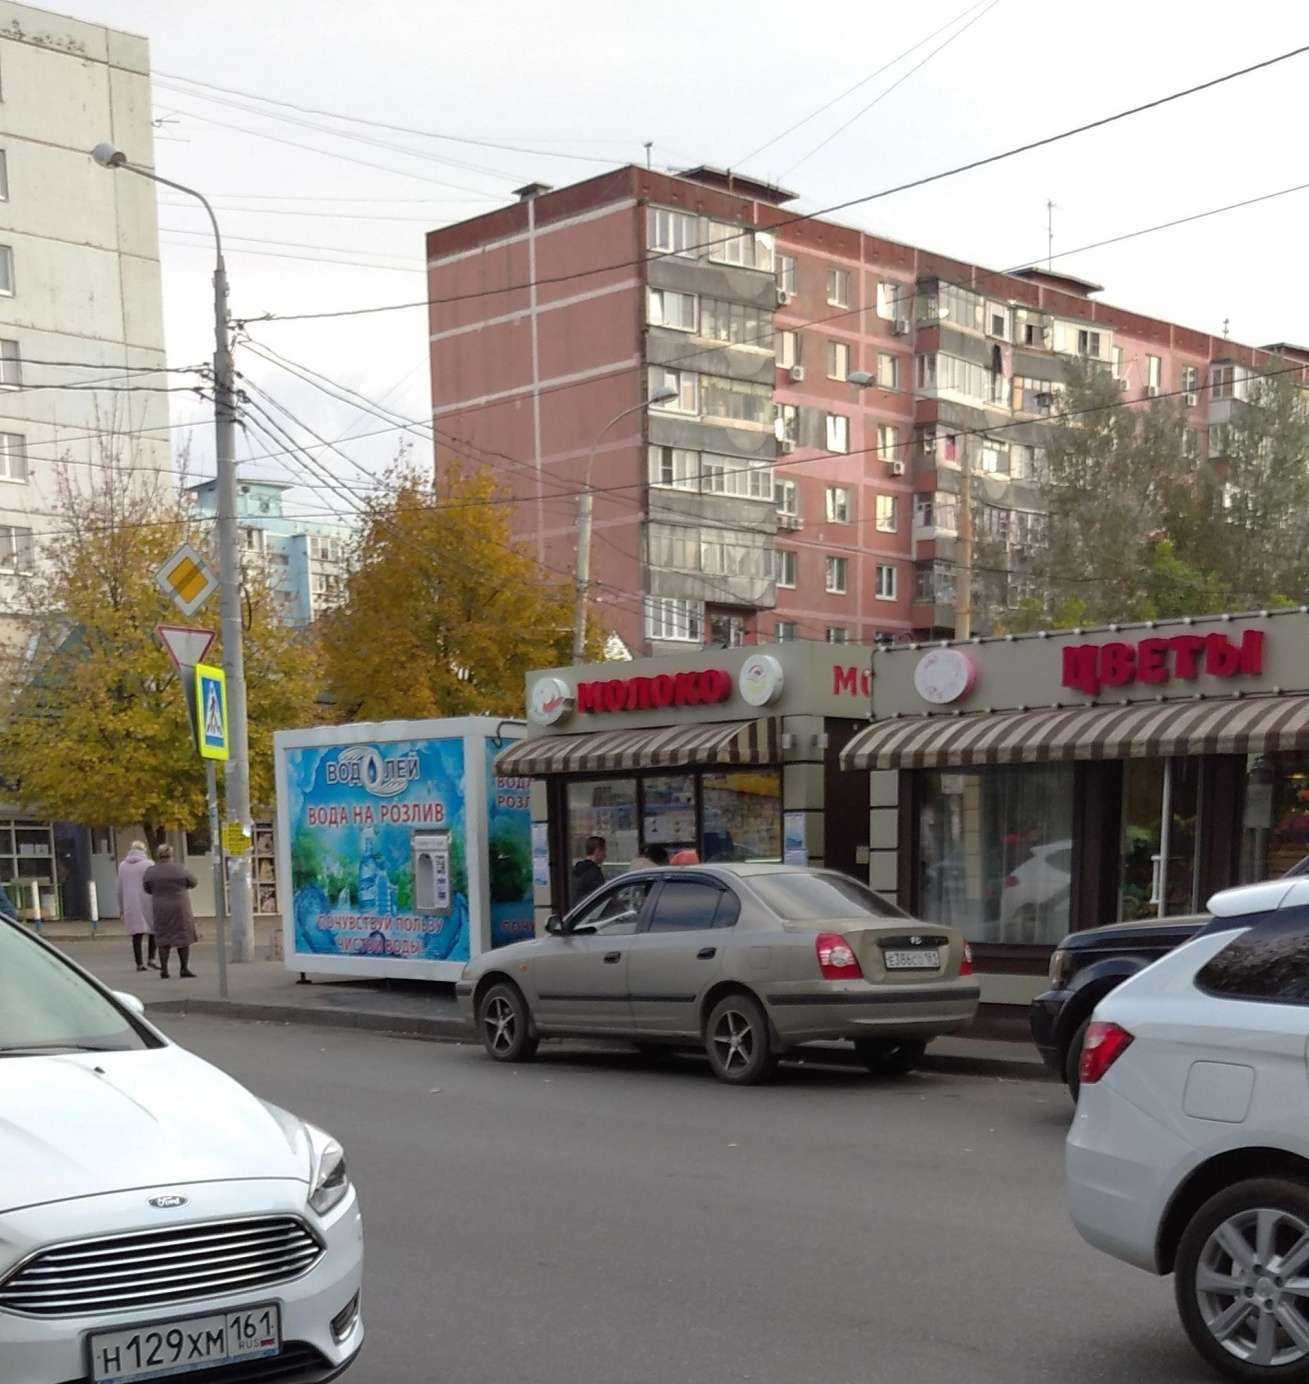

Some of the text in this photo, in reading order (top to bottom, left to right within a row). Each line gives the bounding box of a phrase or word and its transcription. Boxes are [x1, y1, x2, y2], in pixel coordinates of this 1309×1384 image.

[1061, 629, 1265, 696] ЦВЕТЫ
[577, 668, 732, 714] МОЛОКО
[308, 803, 445, 826] ВОДА НА РОЗЛИВ
[103, 1311, 272, 1373] Н129ХМ 161
[238, 1341, 260, 1350] RUS
